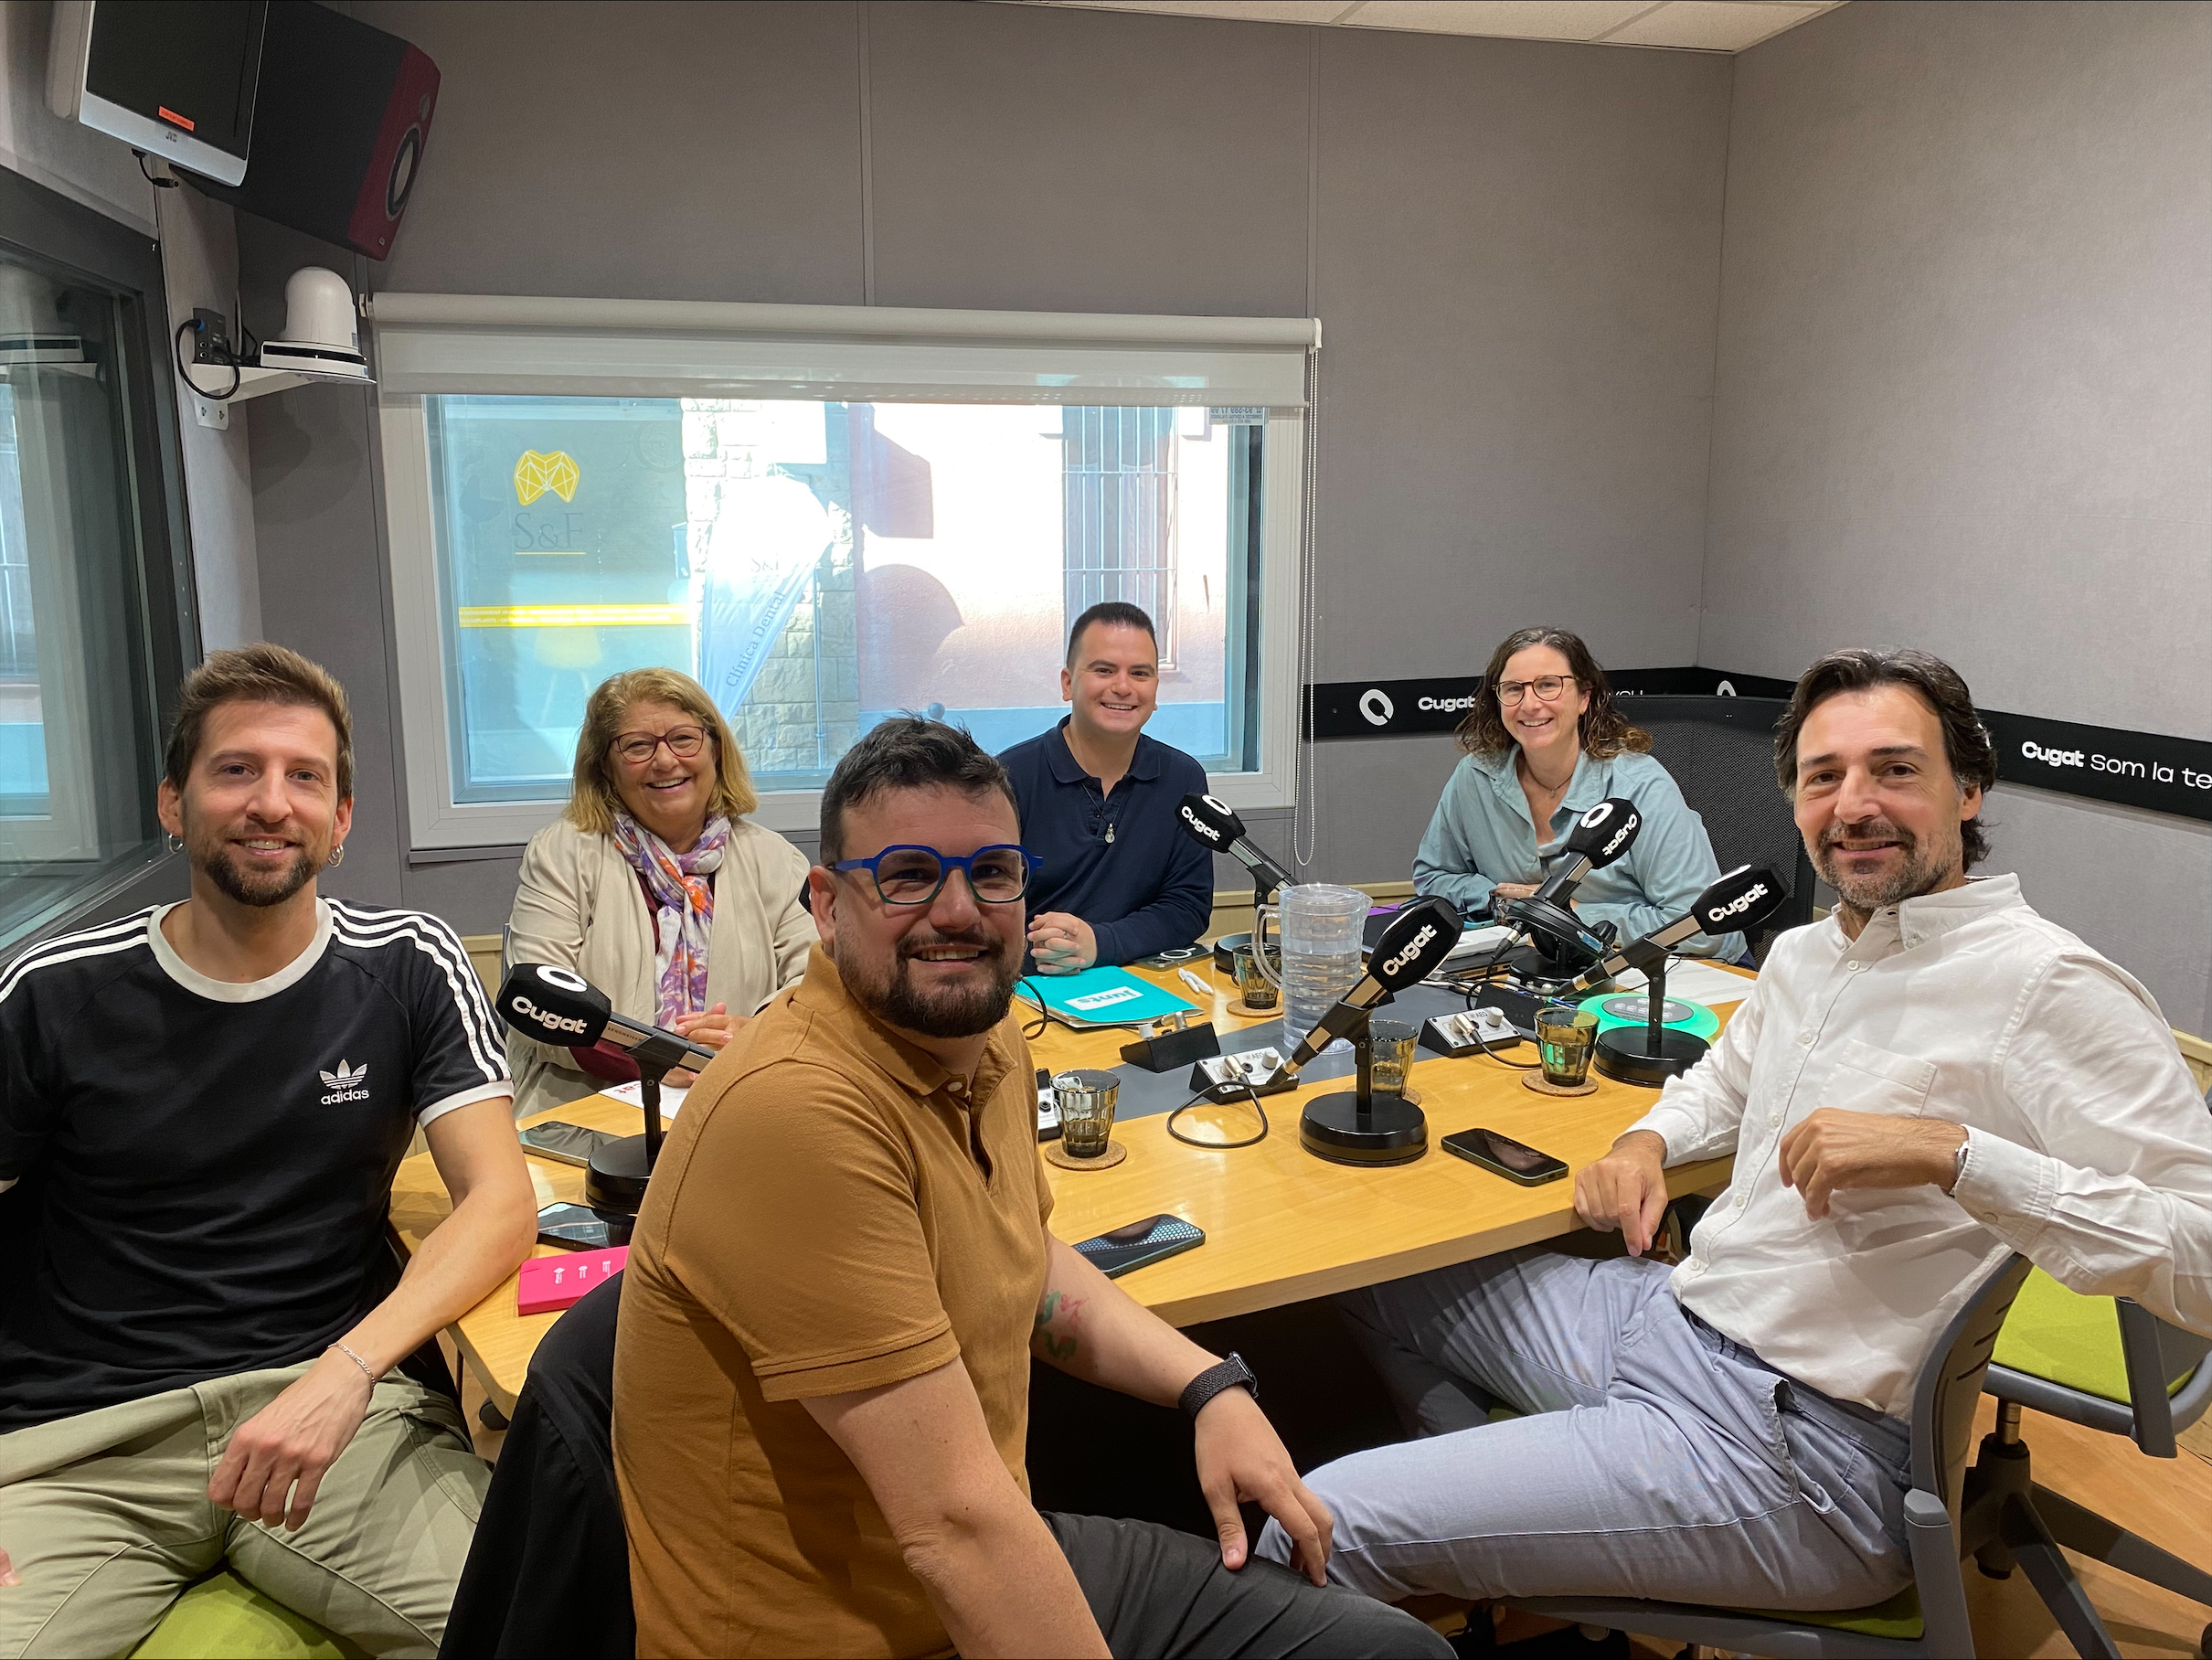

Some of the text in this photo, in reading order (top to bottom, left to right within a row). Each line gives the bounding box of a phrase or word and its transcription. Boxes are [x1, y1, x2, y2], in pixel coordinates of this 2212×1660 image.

[515, 512, 583, 549] S&F
[726, 641, 760, 687] Clínica
[752, 591, 785, 639] Dental
[1418, 695, 1476, 712] Cugat
[2021, 740, 2085, 768] Cugat
[2090, 753, 2146, 779] som
[2152, 761, 2175, 783] la
[1181, 805, 1221, 842] Cugat
[1601, 813, 1638, 857] Cugat
[1707, 882, 1770, 922] Cugat
[1382, 923, 1438, 976] Cugat
[511, 995, 588, 1035] Cugat
[1076, 989, 1137, 1004] junts
[320, 1089, 369, 1105] adidas
